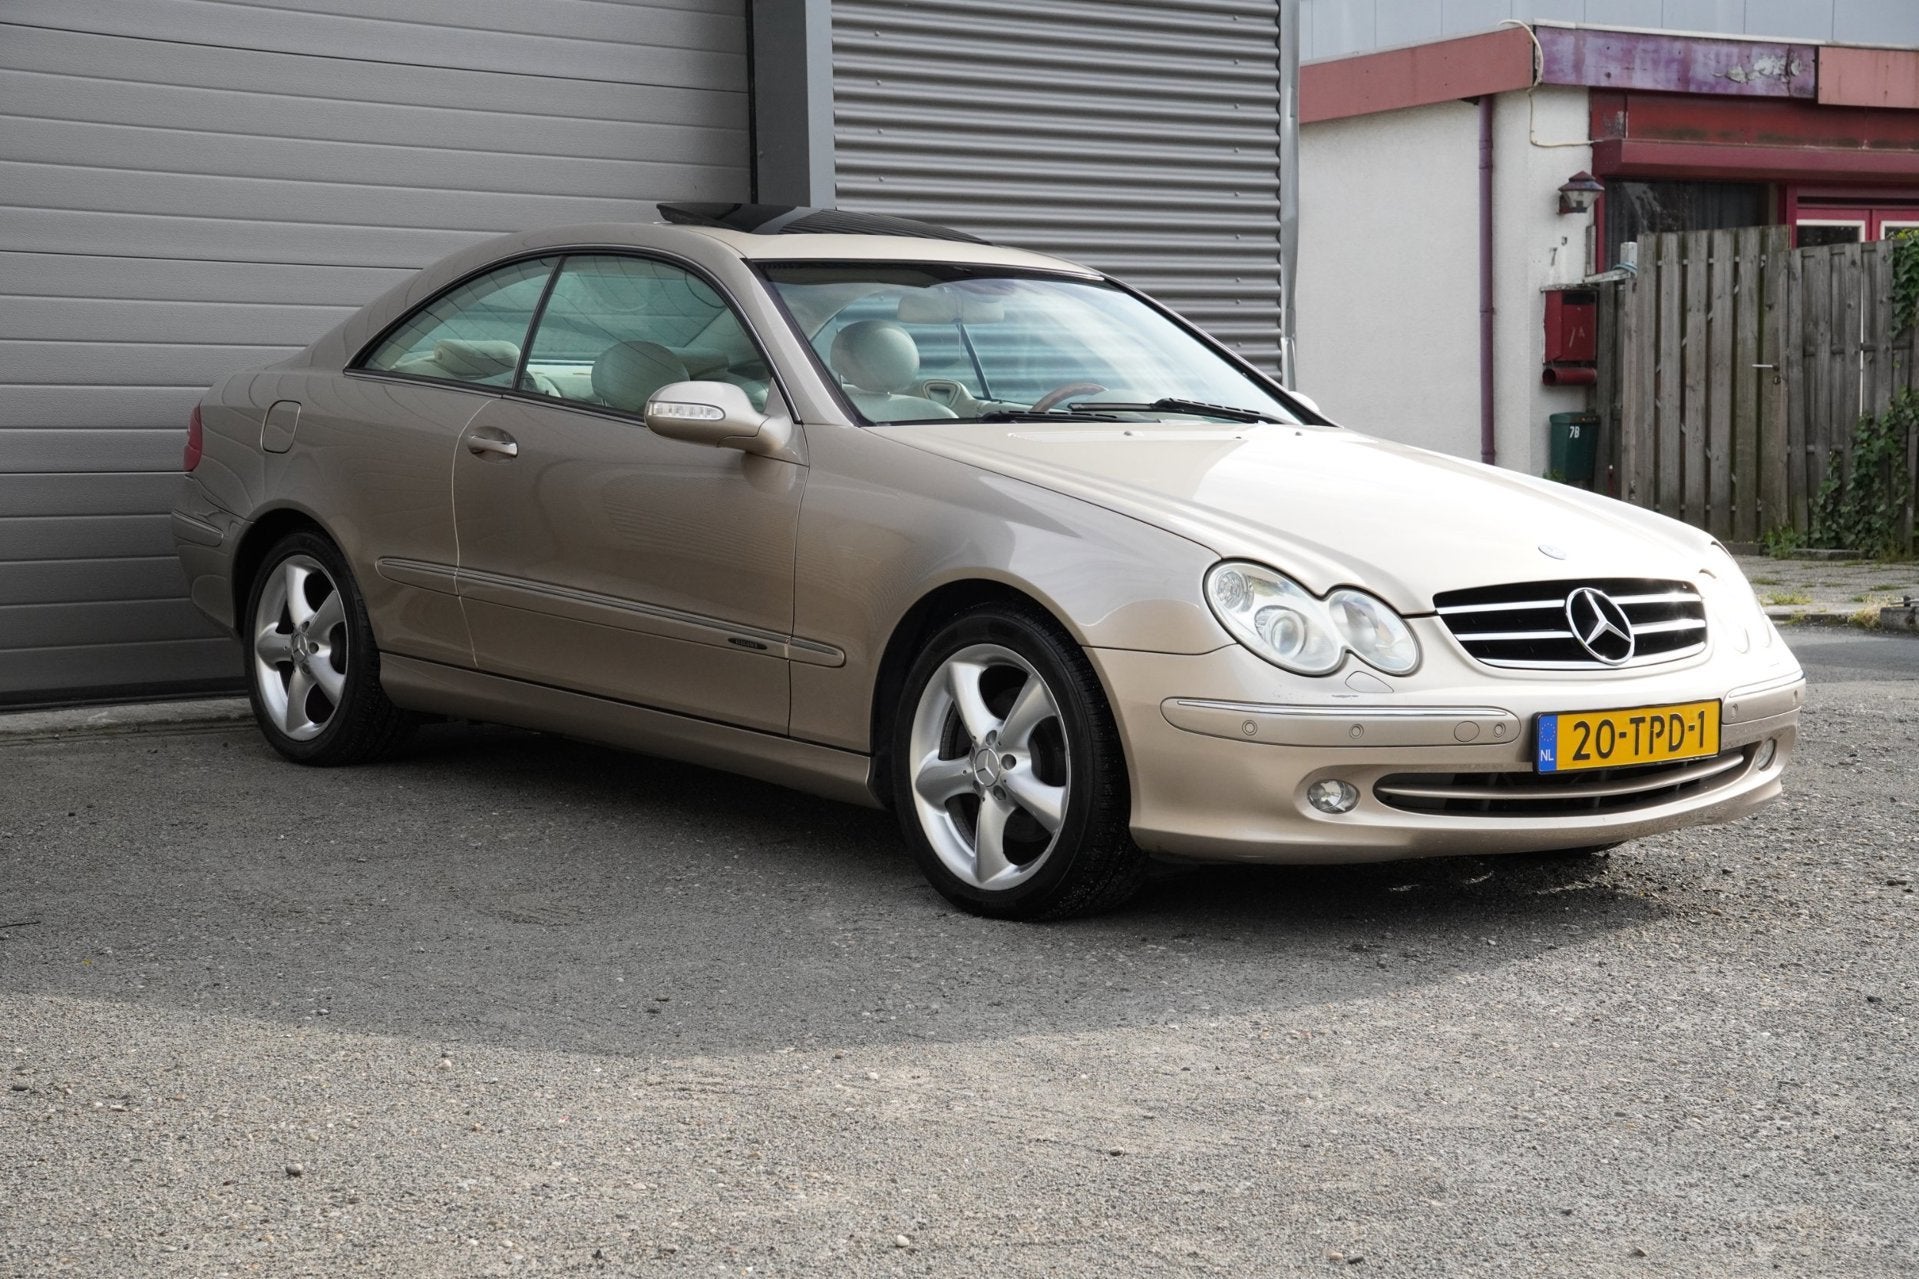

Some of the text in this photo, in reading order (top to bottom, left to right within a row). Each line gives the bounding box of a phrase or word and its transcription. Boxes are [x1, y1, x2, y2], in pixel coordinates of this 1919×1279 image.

[1569, 425, 1580, 439] 7B
[1572, 710, 1705, 762] 20-TPD-1
[1540, 749, 1554, 762] NL
